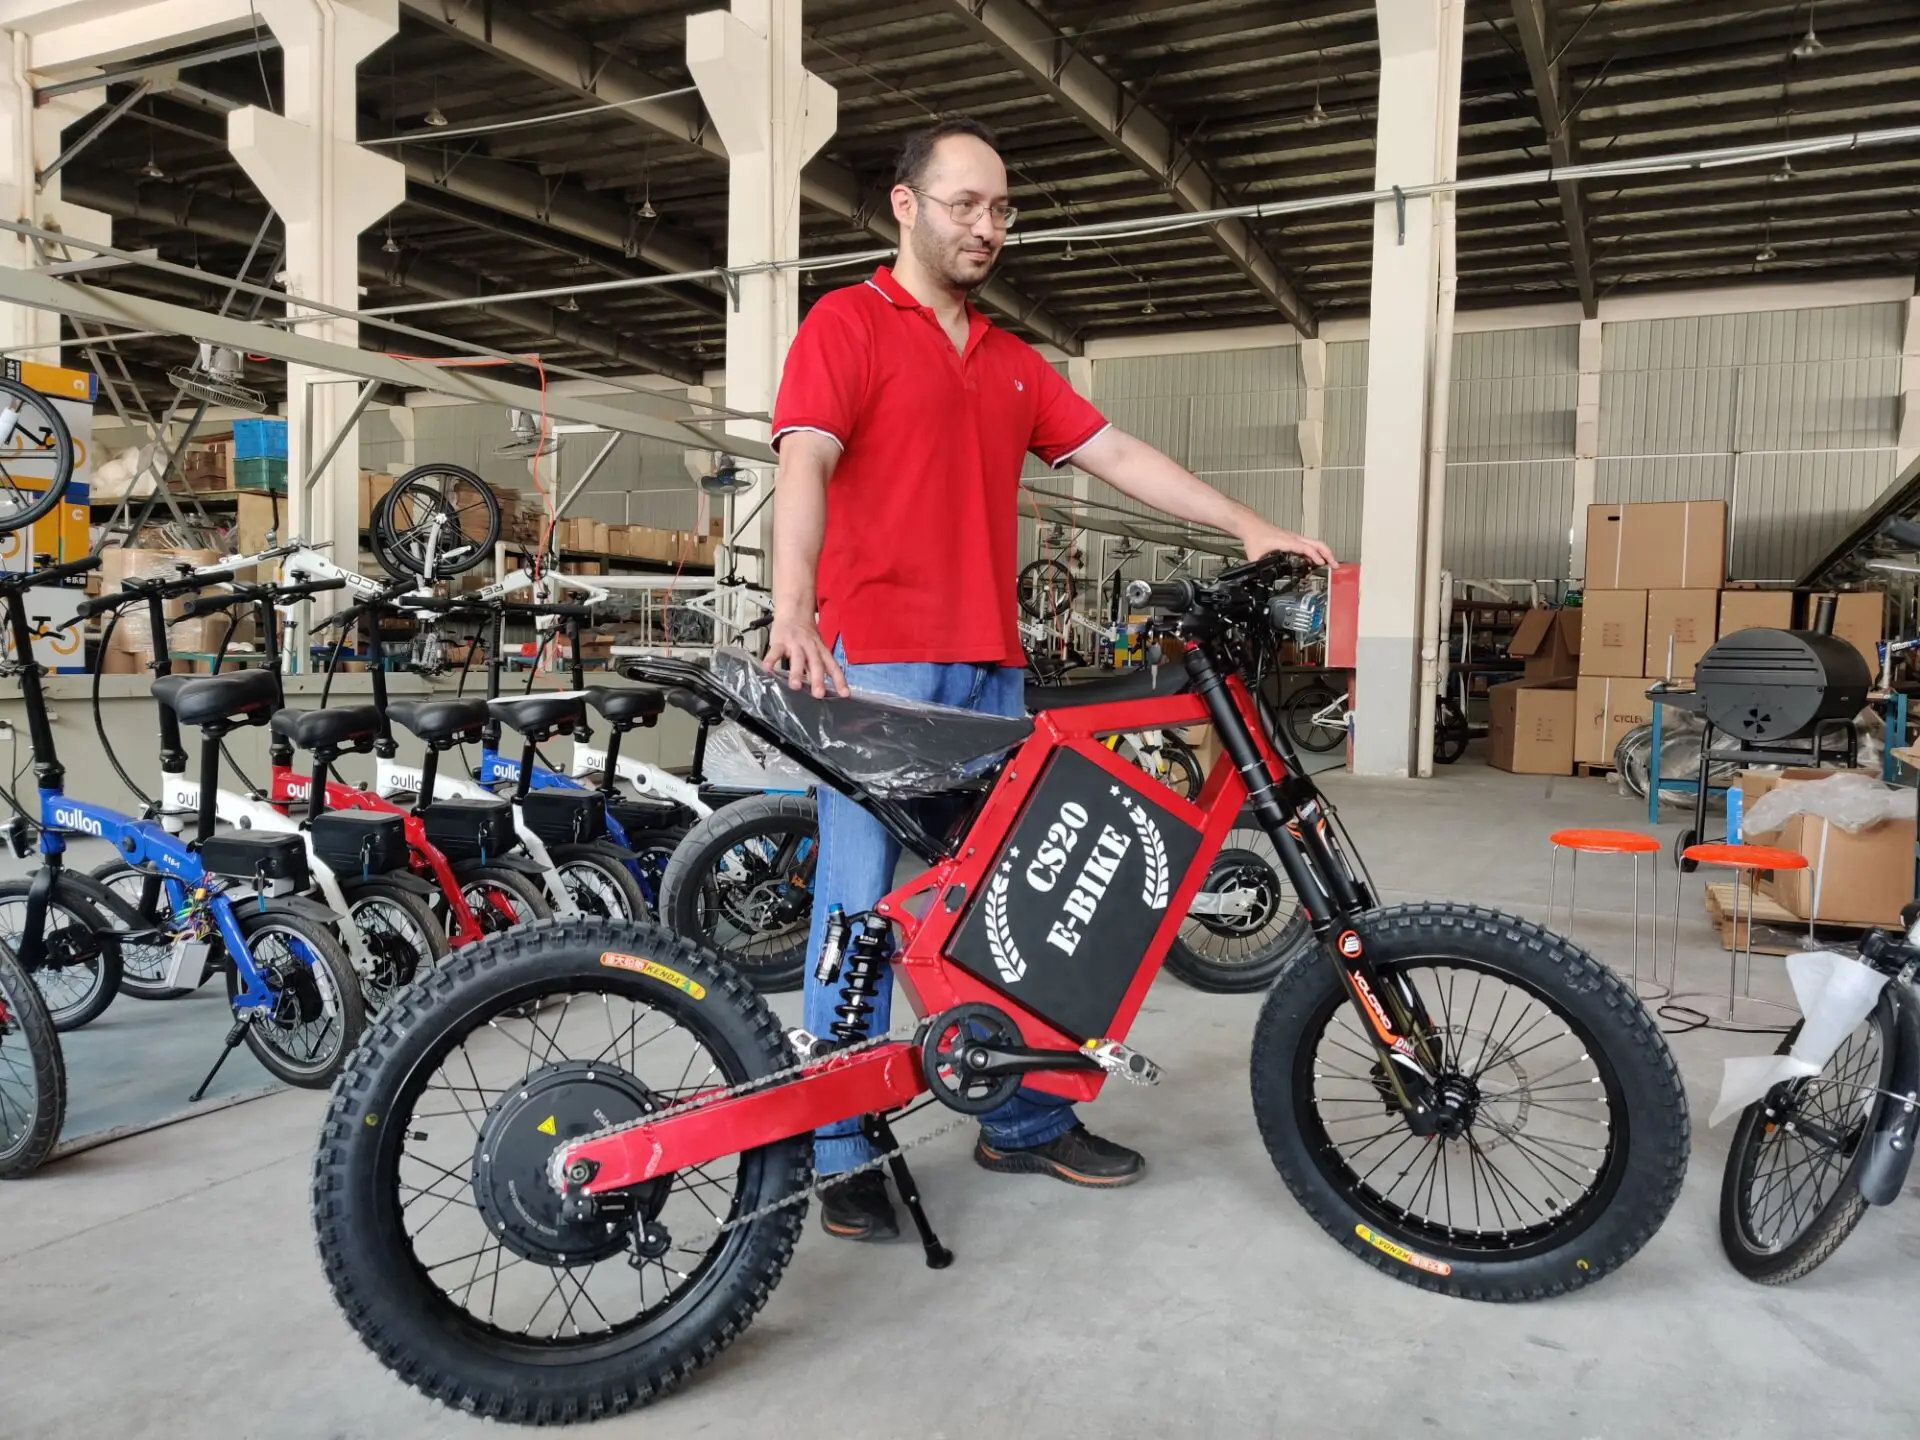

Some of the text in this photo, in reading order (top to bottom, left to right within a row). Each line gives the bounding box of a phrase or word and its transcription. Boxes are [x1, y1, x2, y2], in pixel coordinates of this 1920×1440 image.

[56, 808, 103, 836] oullon
[1026, 802, 1089, 893] CS20
[1046, 824, 1132, 957] E-BIKE
[646, 964, 681, 985] KENDA
[1379, 1239, 1411, 1260] KENDA
